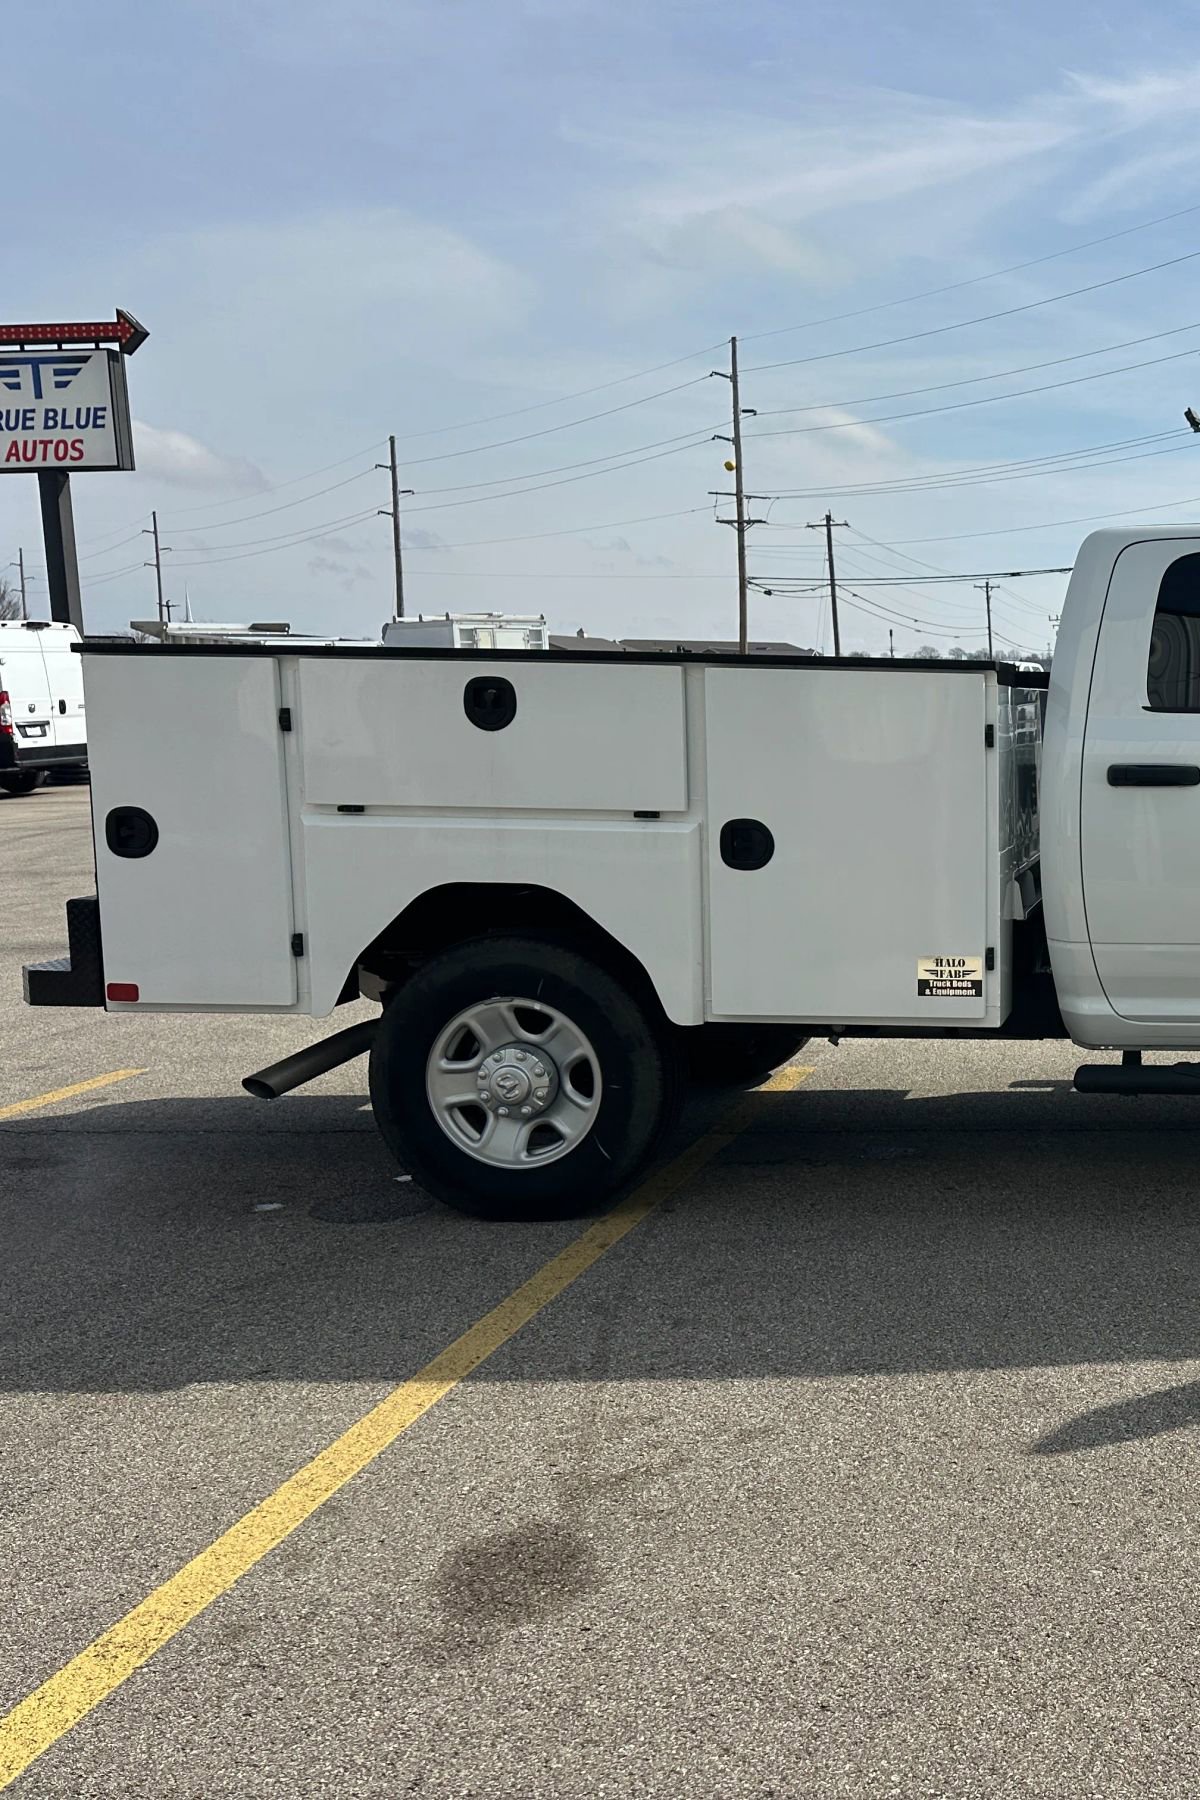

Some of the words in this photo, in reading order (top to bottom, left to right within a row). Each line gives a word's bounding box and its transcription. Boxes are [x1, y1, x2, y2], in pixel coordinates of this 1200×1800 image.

[43, 407, 107, 430] BLUE
[5, 439, 84, 462] AUTOS
[935, 958, 966, 968] HALO
[929, 980, 951, 988] Truck
[952, 980, 972, 988] Beds
[932, 988, 976, 996] Equipment
